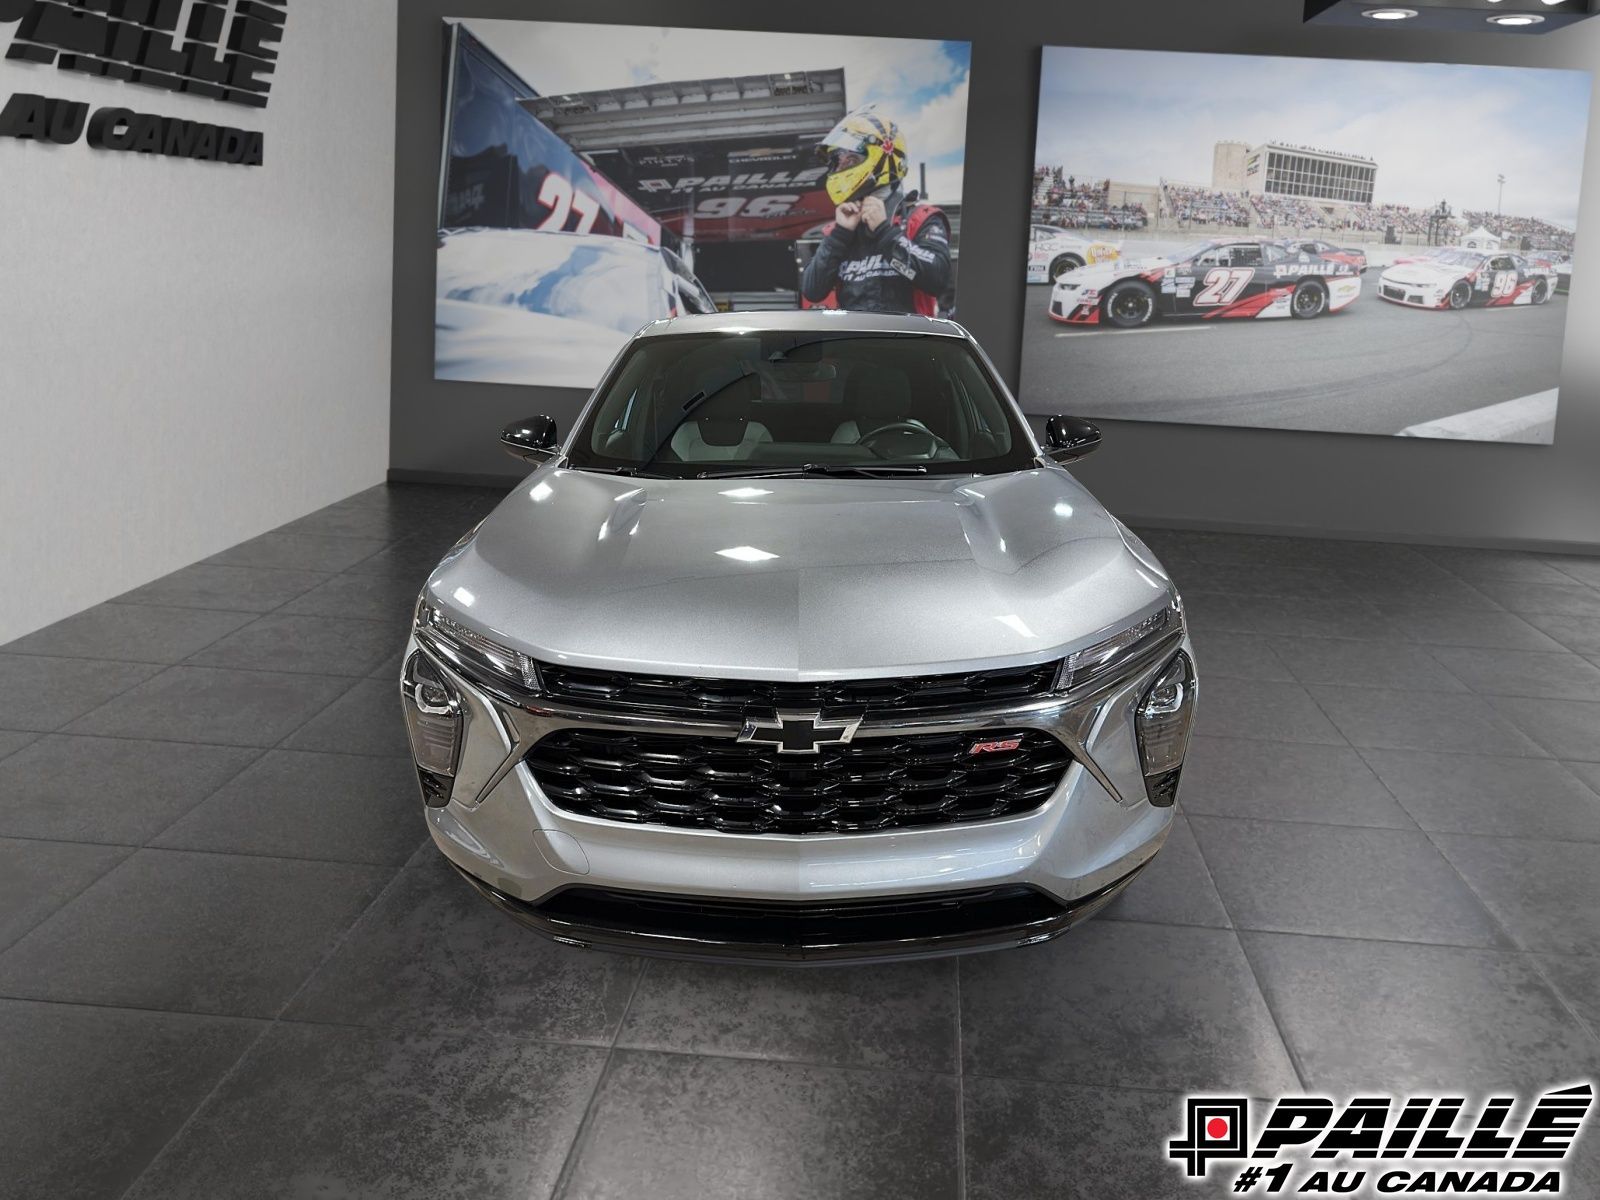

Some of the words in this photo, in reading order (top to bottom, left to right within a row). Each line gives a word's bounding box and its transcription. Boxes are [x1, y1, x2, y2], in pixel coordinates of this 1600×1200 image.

[0, 93, 90, 144] AU
[87, 107, 263, 166] CANADA
[536, 171, 600, 235] 27
[694, 195, 800, 218] 96
[1193, 267, 1255, 306] 27
[1491, 269, 1518, 298] 96
[969, 740, 1021, 754] RS
